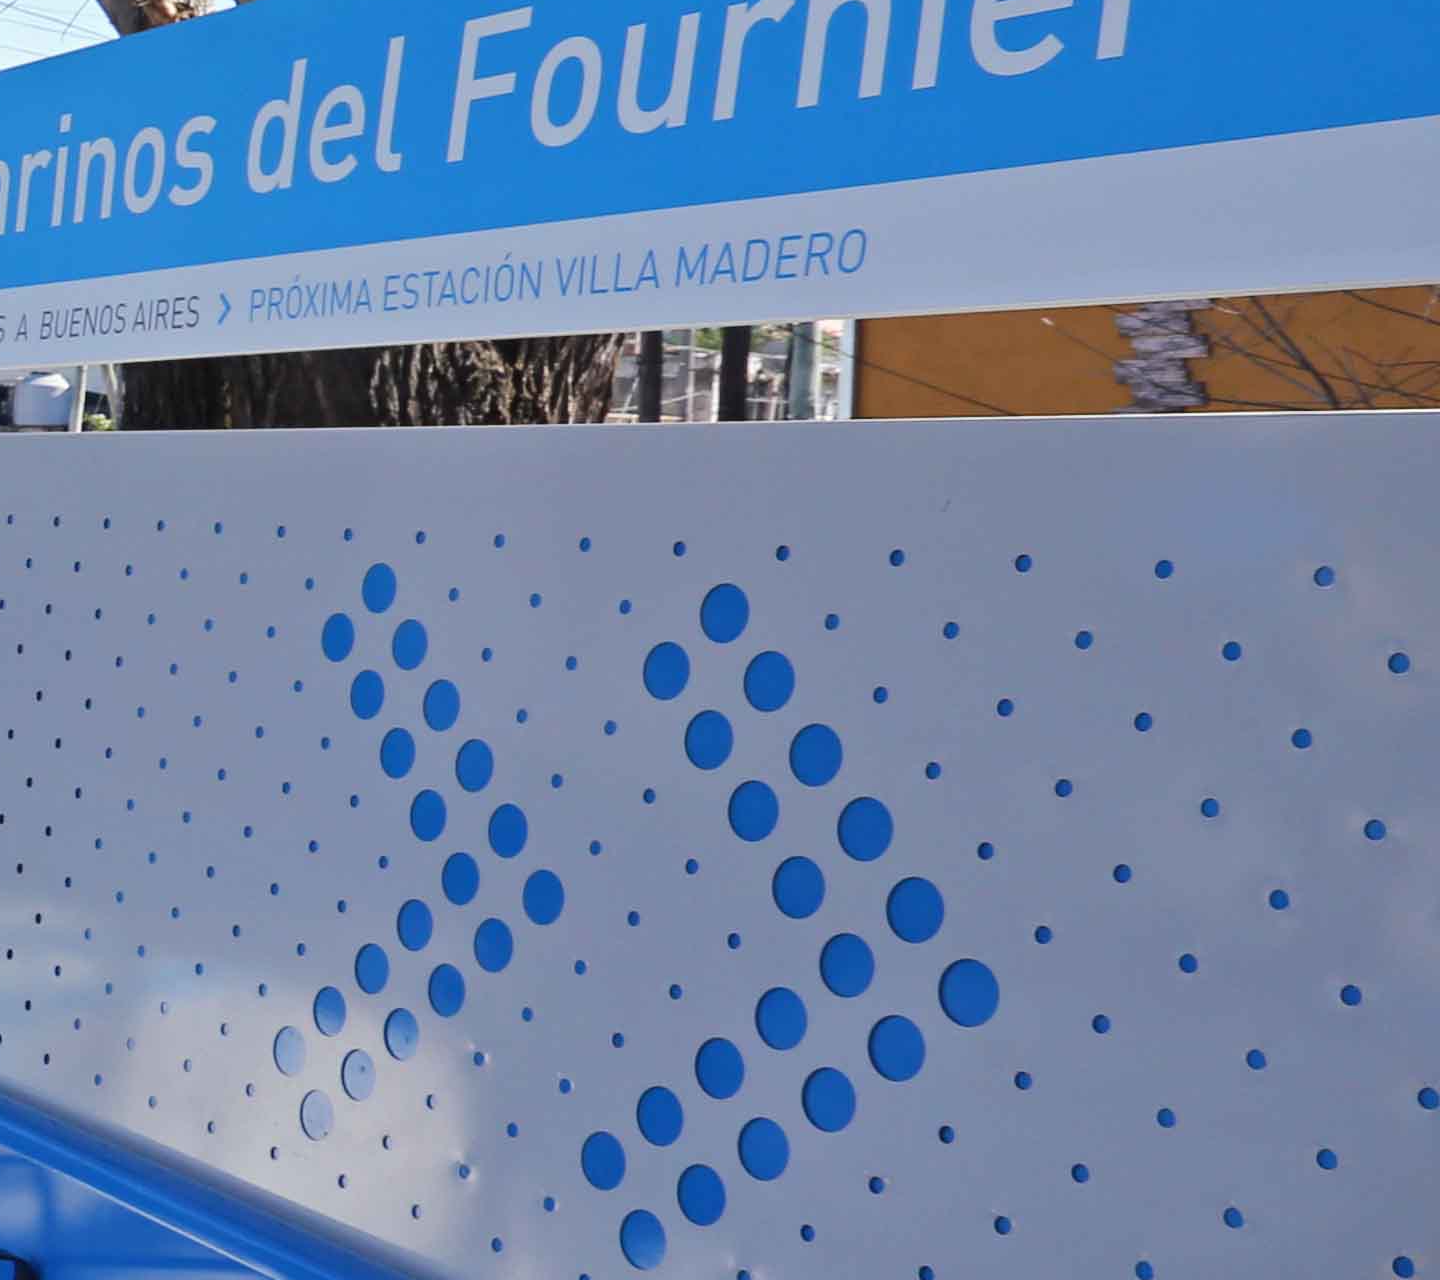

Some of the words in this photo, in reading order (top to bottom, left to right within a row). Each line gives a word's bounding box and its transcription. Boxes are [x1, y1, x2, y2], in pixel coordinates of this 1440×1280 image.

[244, 36, 406, 196] del
[15, 313, 29, 342] A
[39, 302, 127, 340] BUENOS
[132, 295, 201, 332] AIRES
[248, 274, 373, 322] PRÓXIMA
[382, 252, 543, 312] ESTACIÓN
[556, 249, 661, 297] VILLA
[674, 228, 868, 287] MADERO
